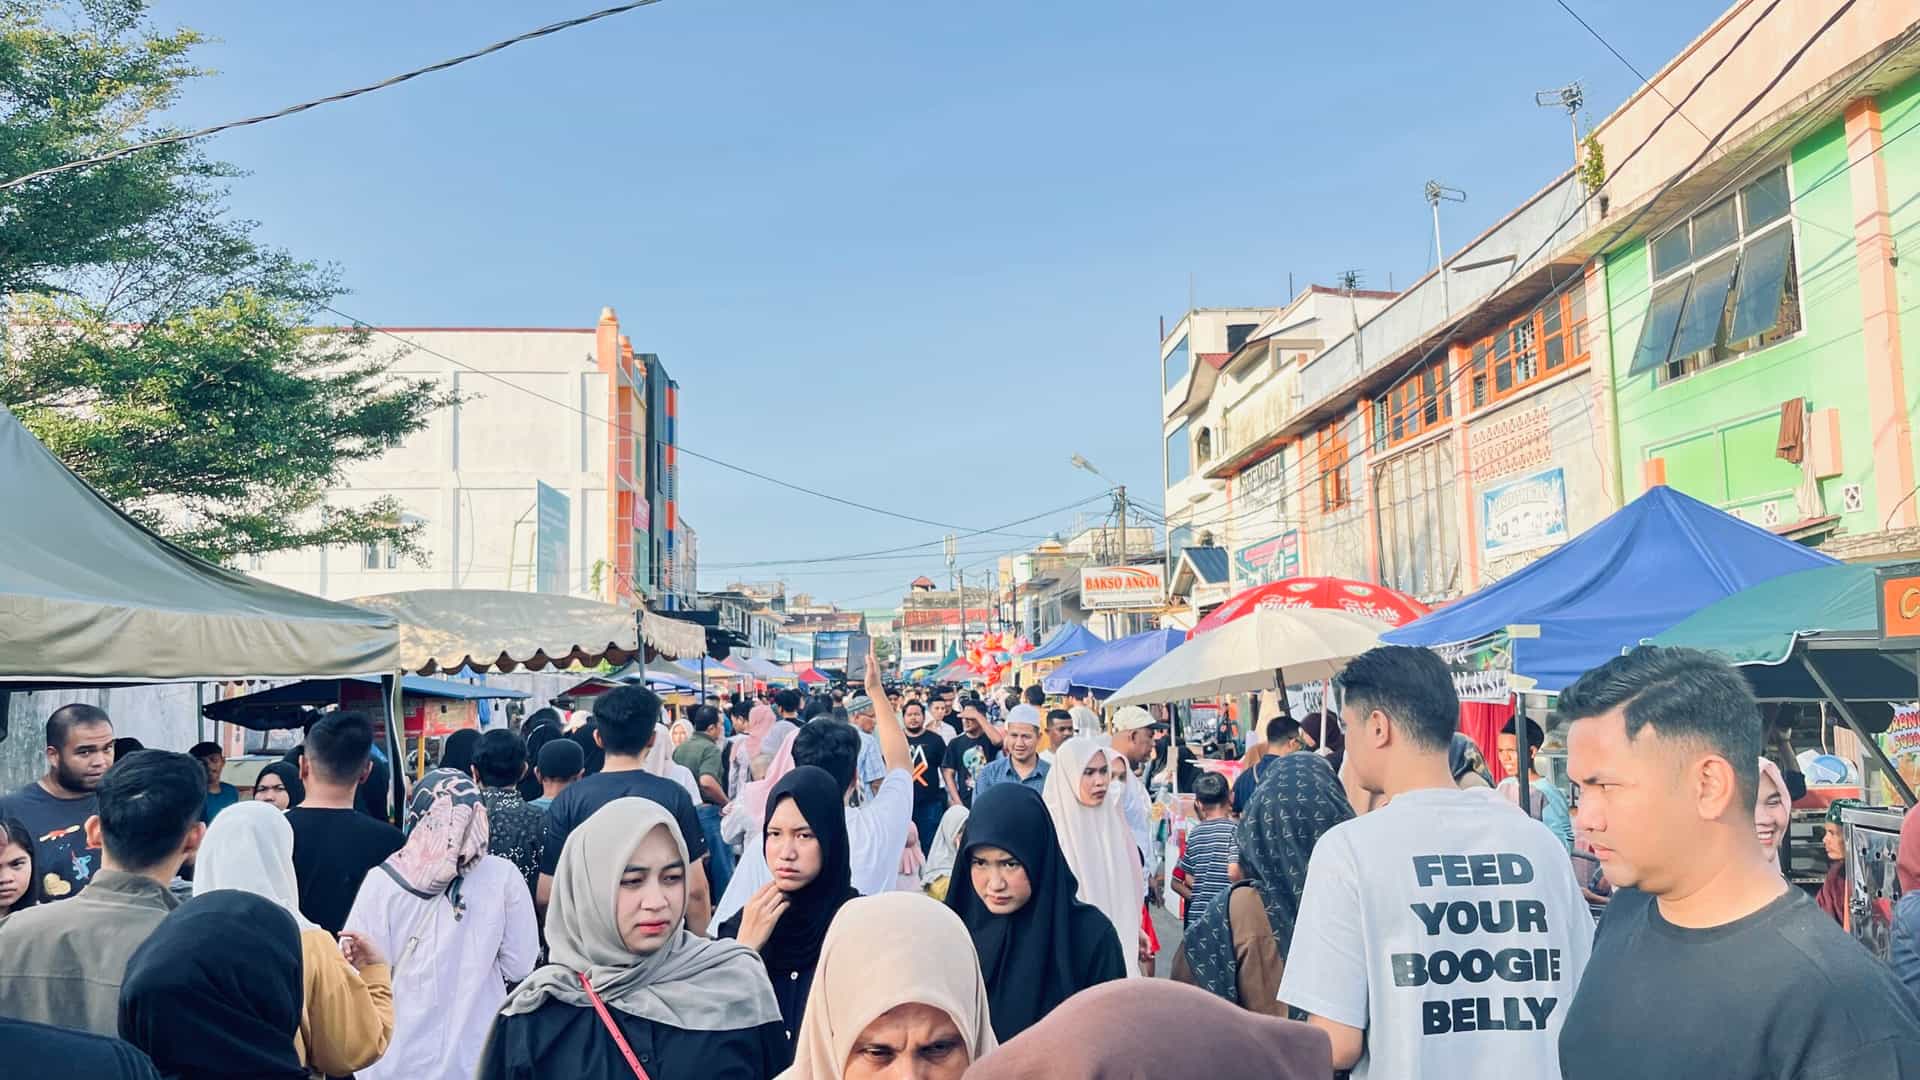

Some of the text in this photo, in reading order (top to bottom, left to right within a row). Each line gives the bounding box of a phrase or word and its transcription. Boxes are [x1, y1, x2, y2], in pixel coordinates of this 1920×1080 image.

[1085, 576, 1123, 591] BAKSO
[1412, 853, 1534, 887] FEED
[1410, 900, 1548, 935] YOUR
[1391, 948, 1561, 987] BOOGIE
[1422, 997, 1558, 1035] BELLY
